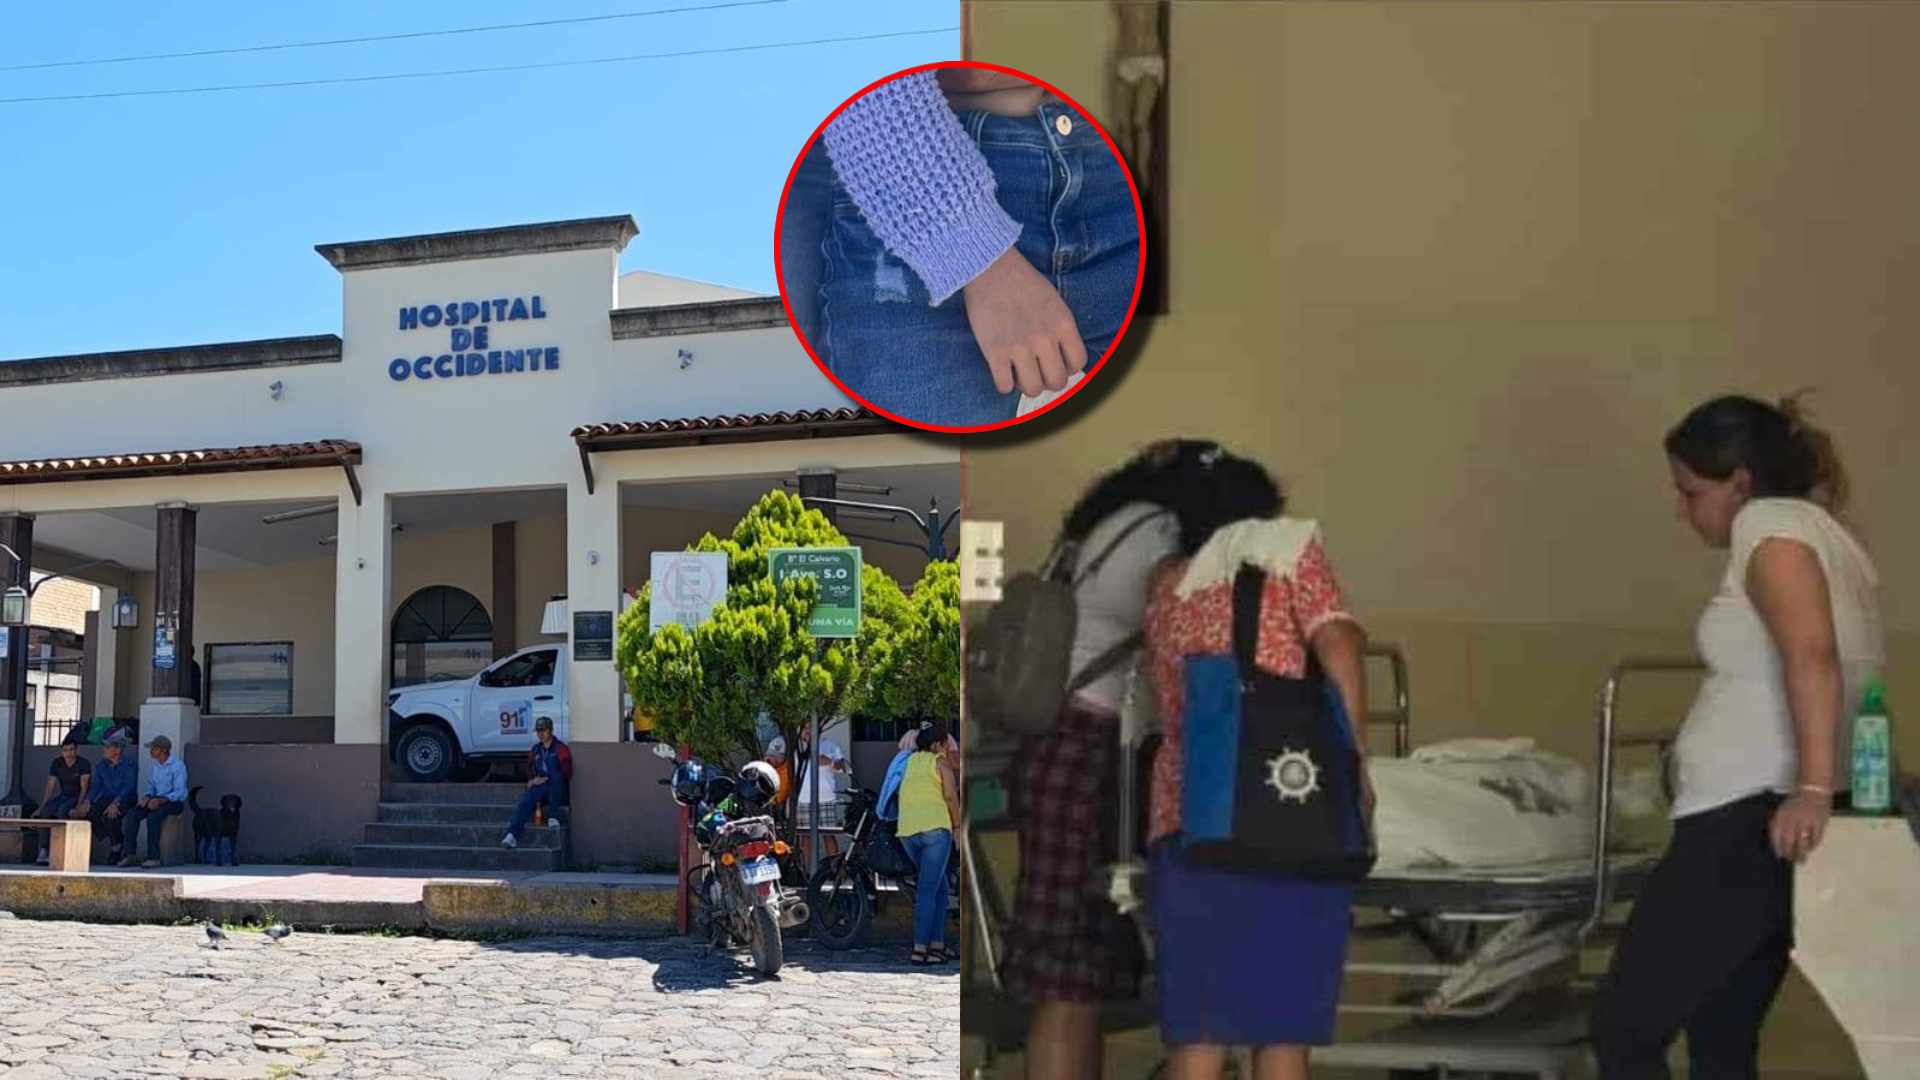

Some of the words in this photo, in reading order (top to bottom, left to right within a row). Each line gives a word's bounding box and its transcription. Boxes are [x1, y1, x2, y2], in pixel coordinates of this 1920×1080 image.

[399, 296, 546, 330] HOSPITAL
[451, 325, 489, 352] DE
[388, 347, 560, 381] OCCIDENTE
